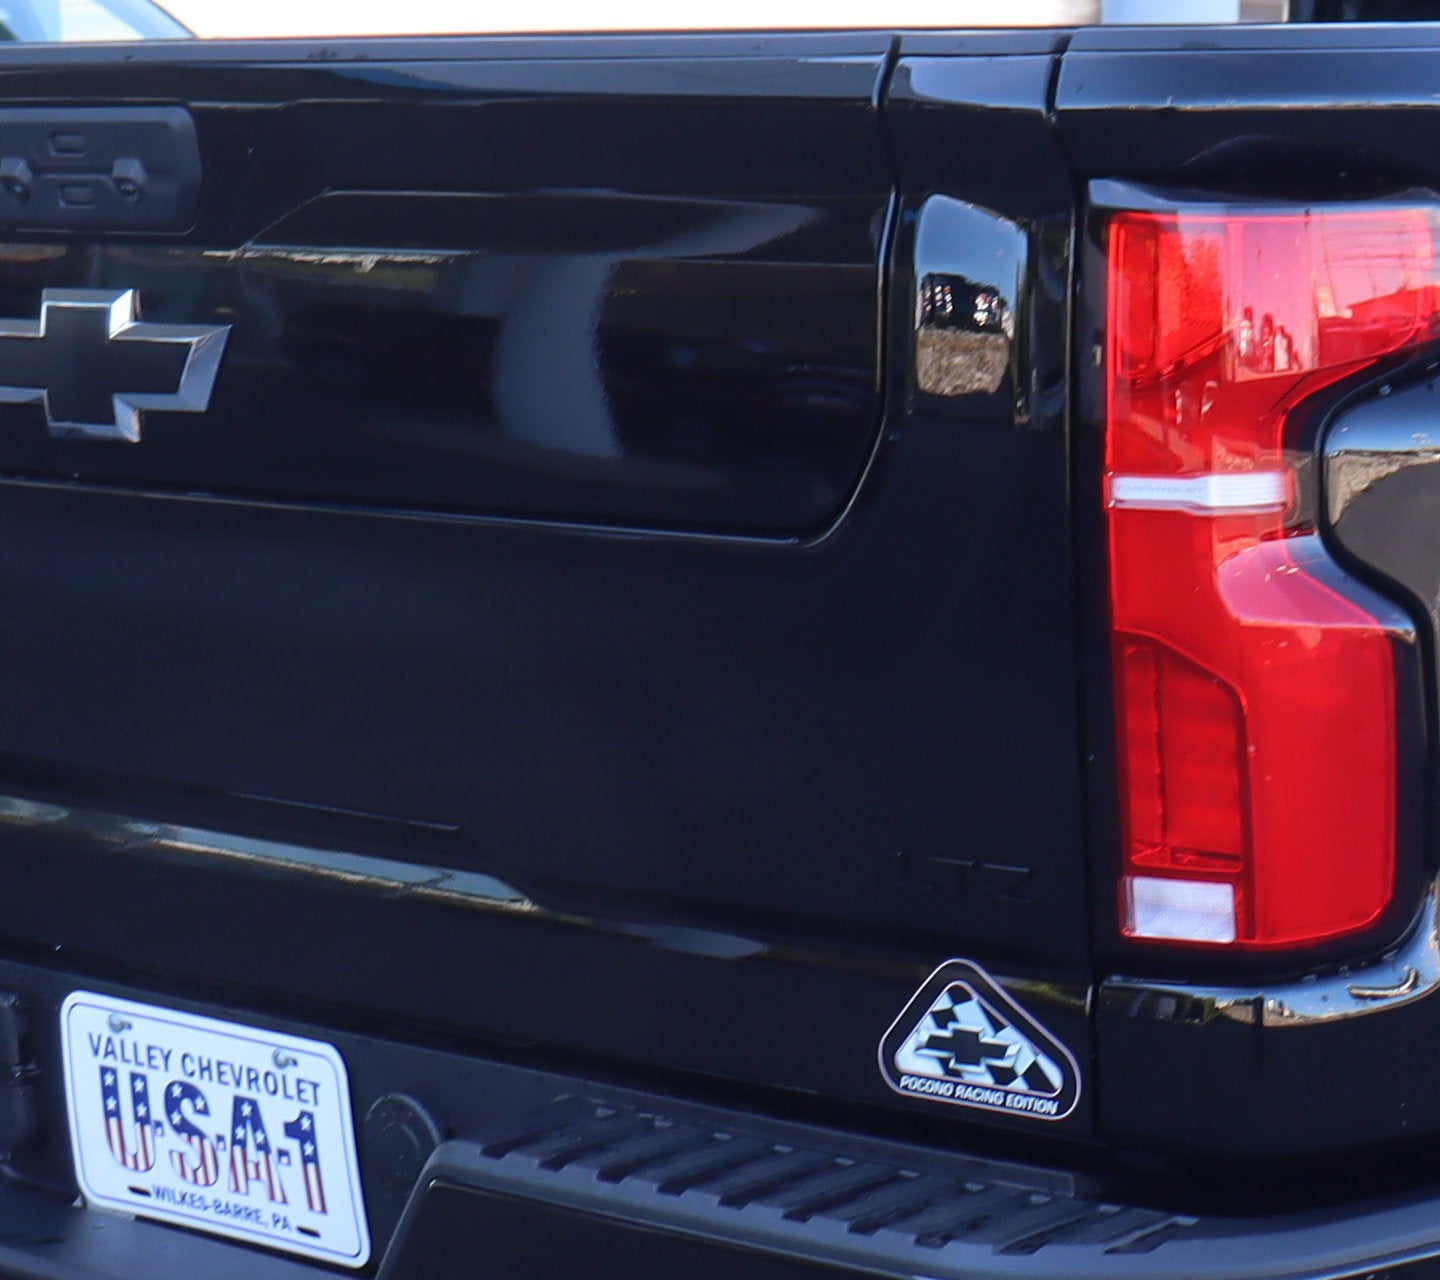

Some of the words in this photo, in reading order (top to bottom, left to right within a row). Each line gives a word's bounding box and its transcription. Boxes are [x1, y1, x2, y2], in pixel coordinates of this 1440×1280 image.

[87, 1032, 171, 1072] VALLEY
[180, 1053, 320, 1106] CHEVROLET
[899, 1075, 954, 1097] POCONO
[954, 1084, 1005, 1106] RACING
[1005, 1093, 1059, 1115] EDITION
